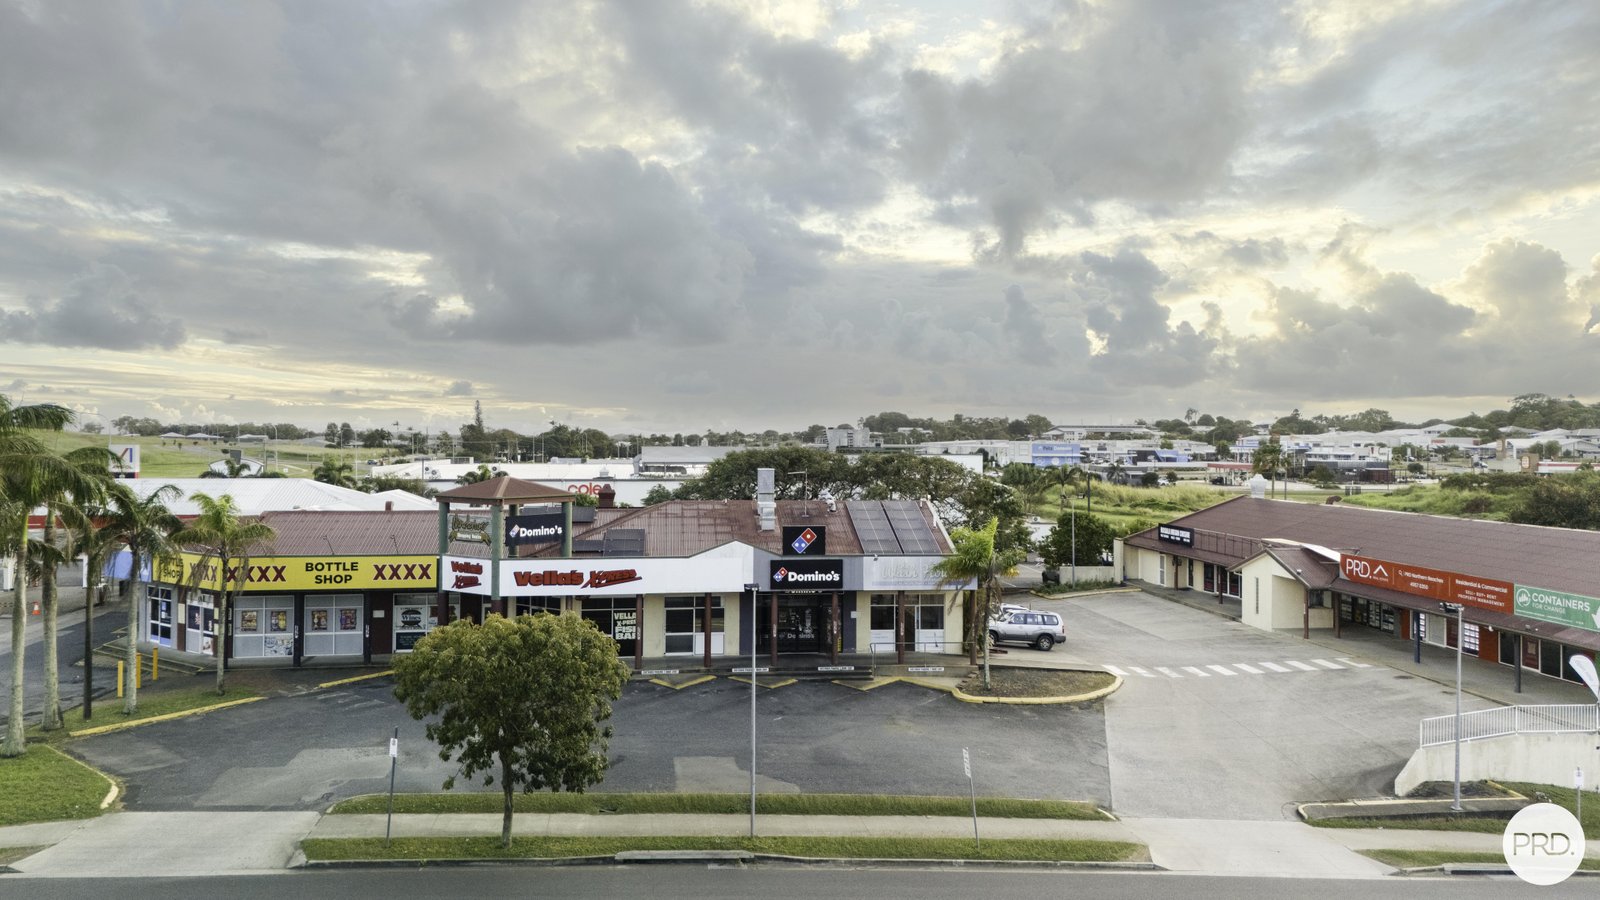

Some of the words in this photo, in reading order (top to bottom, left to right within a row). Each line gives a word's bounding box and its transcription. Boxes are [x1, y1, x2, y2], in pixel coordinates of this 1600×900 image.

[568, 482, 602, 495] cole
[520, 525, 562, 538] Domino's
[305, 562, 359, 572] BOTTLE
[373, 564, 432, 581] XXXX
[1346, 559, 1373, 579] PRD.
[314, 575, 353, 584] SHOP
[788, 571, 841, 582] Domino's
[1532, 592, 1590, 612] CONTAINERS
[1544, 604, 1566, 614] CHANGE
[614, 612, 637, 620] VELLA
